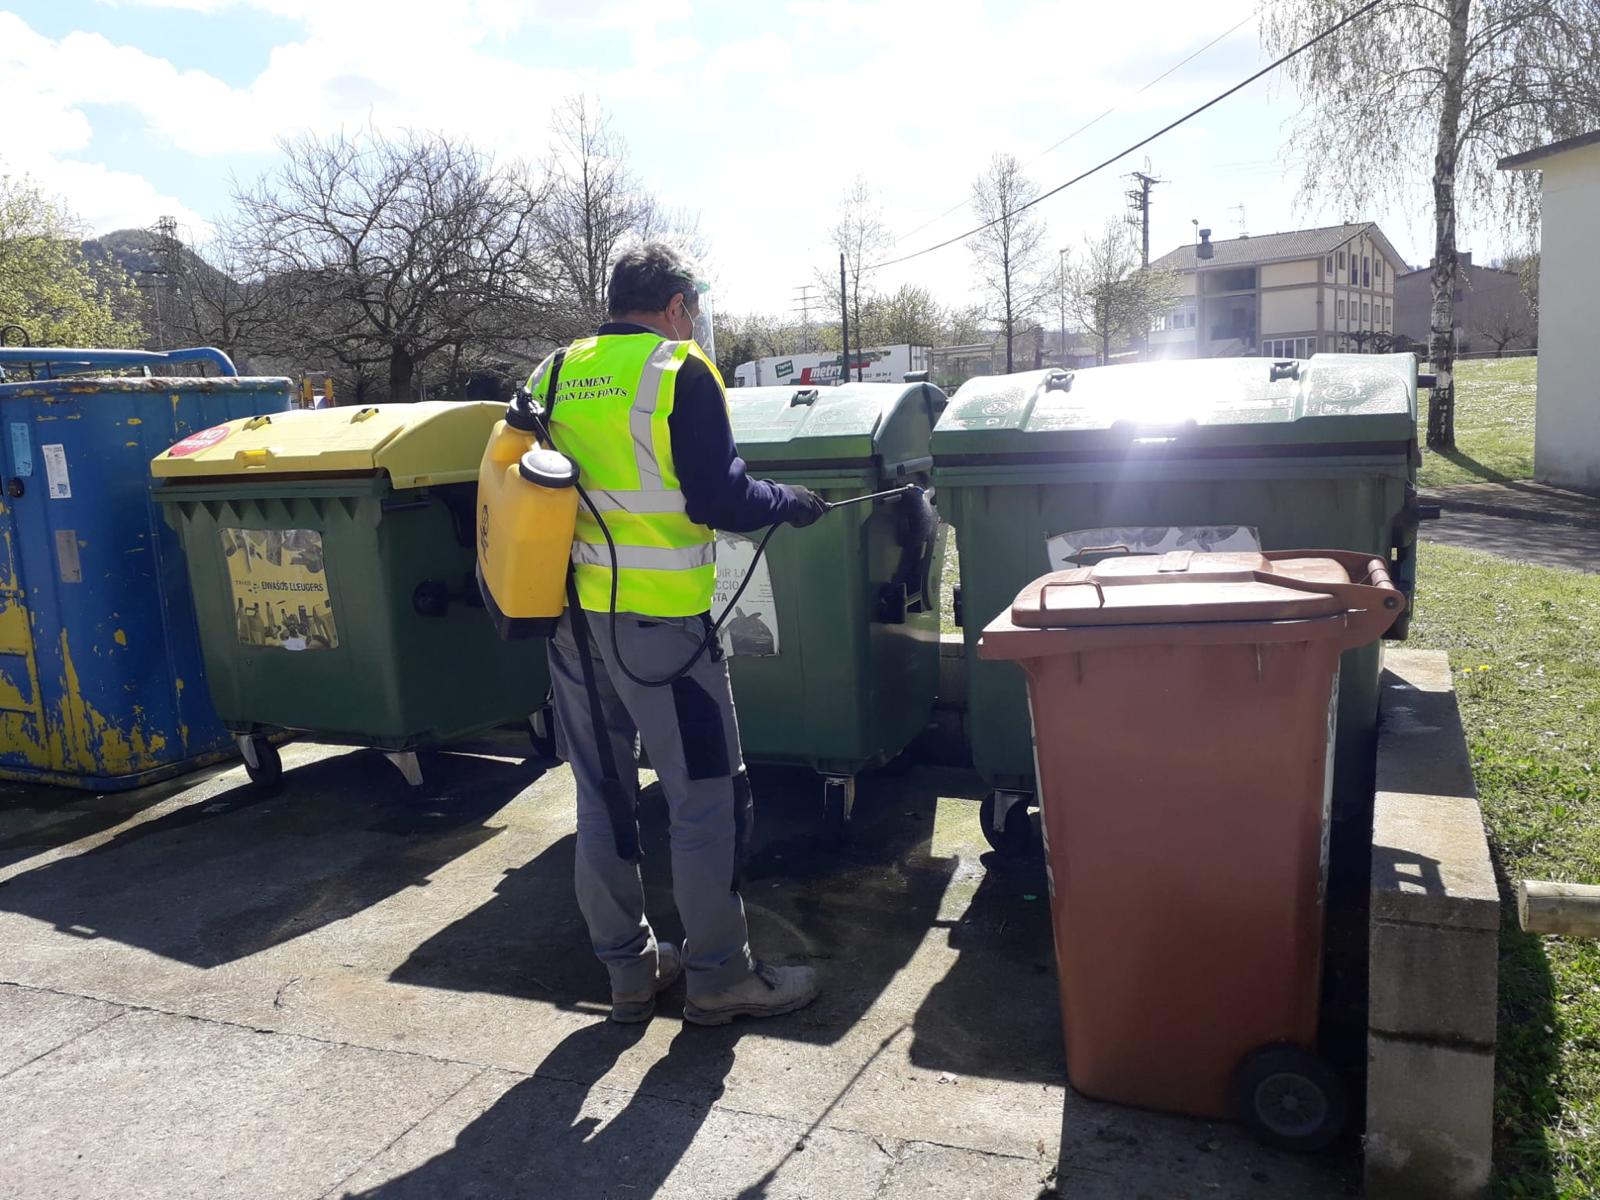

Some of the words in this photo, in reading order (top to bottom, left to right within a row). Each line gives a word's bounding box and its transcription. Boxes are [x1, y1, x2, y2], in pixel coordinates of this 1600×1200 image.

[556, 376, 613, 391] JUNTAMENT
[578, 391, 596, 400] LES
[597, 387, 628, 398] FONTS
